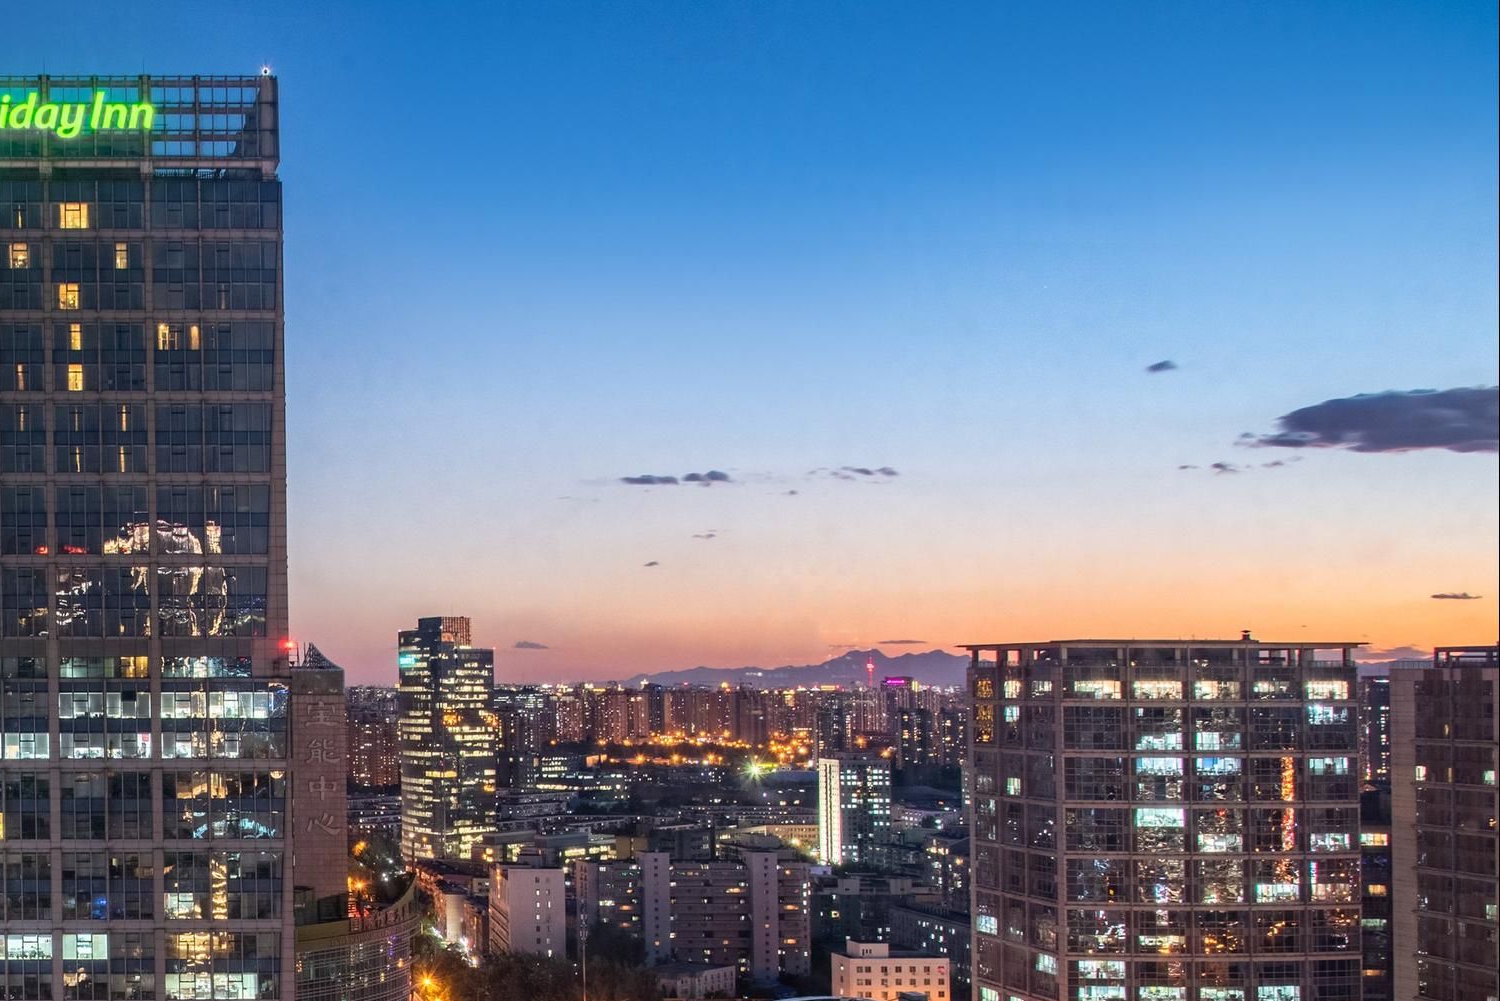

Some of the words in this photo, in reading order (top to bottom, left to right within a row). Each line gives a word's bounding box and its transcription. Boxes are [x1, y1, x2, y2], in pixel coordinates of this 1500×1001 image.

[90, 90, 155, 130] Inn
[305, 701, 341, 836] 宝能中心
